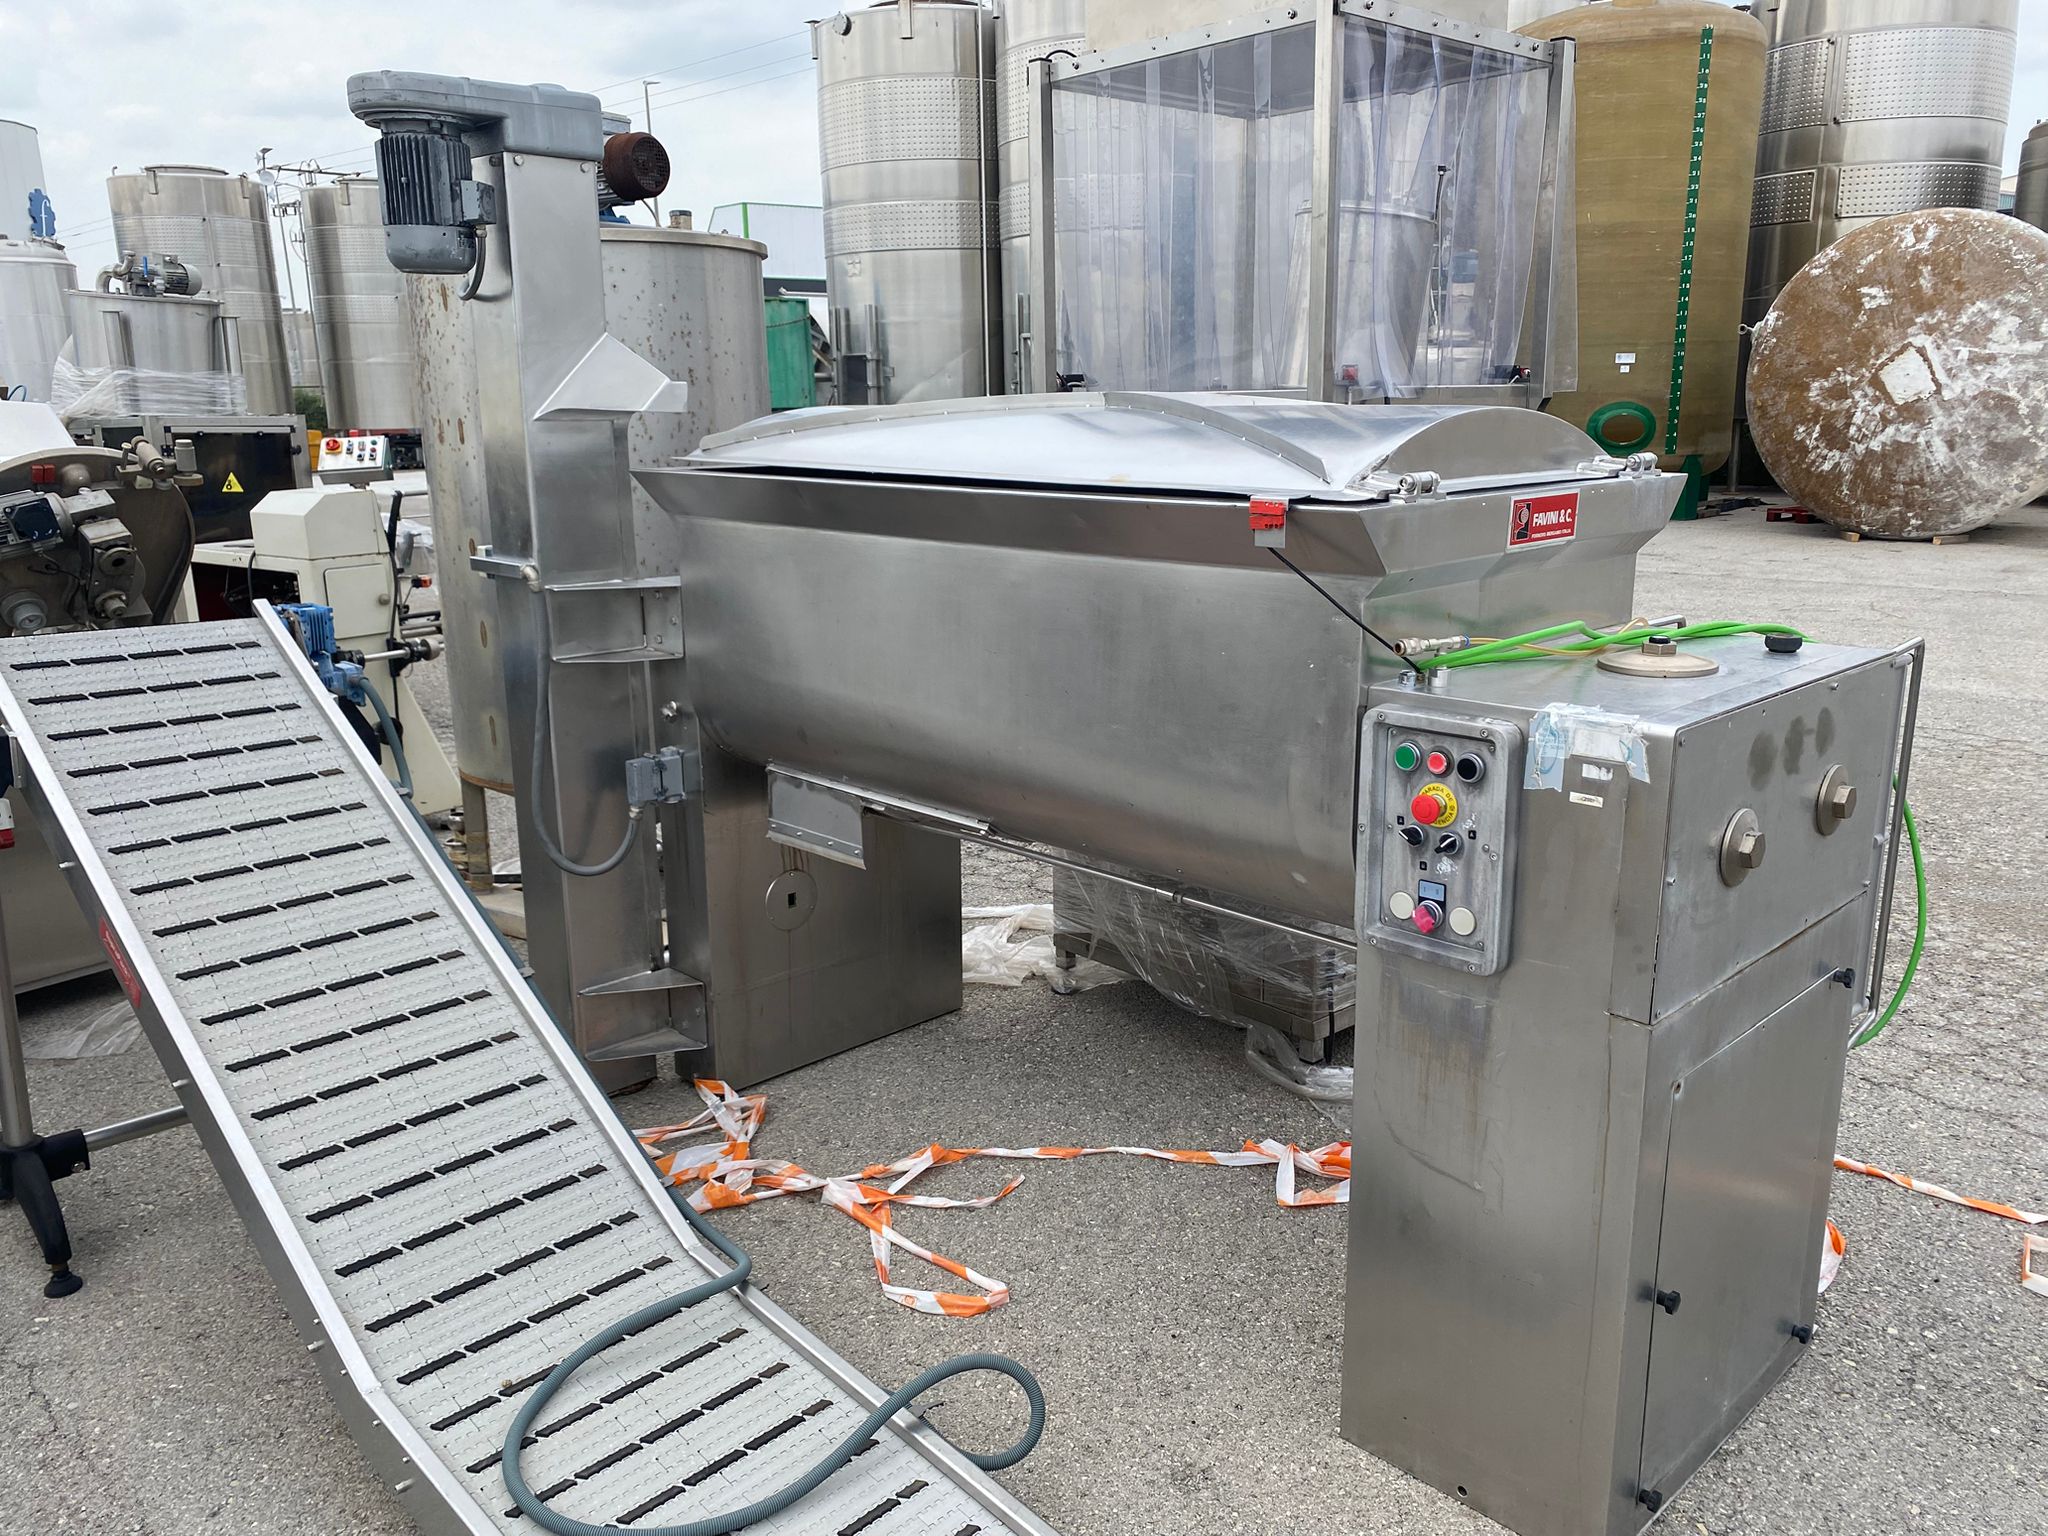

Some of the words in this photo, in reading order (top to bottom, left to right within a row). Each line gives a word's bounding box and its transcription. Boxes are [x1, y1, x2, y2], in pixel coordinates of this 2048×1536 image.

[1532, 510, 1558, 527] FAVINI
[1559, 509, 1565, 523] &
[1566, 508, 1572, 522] C.
[1446, 792, 1454, 802] DE
